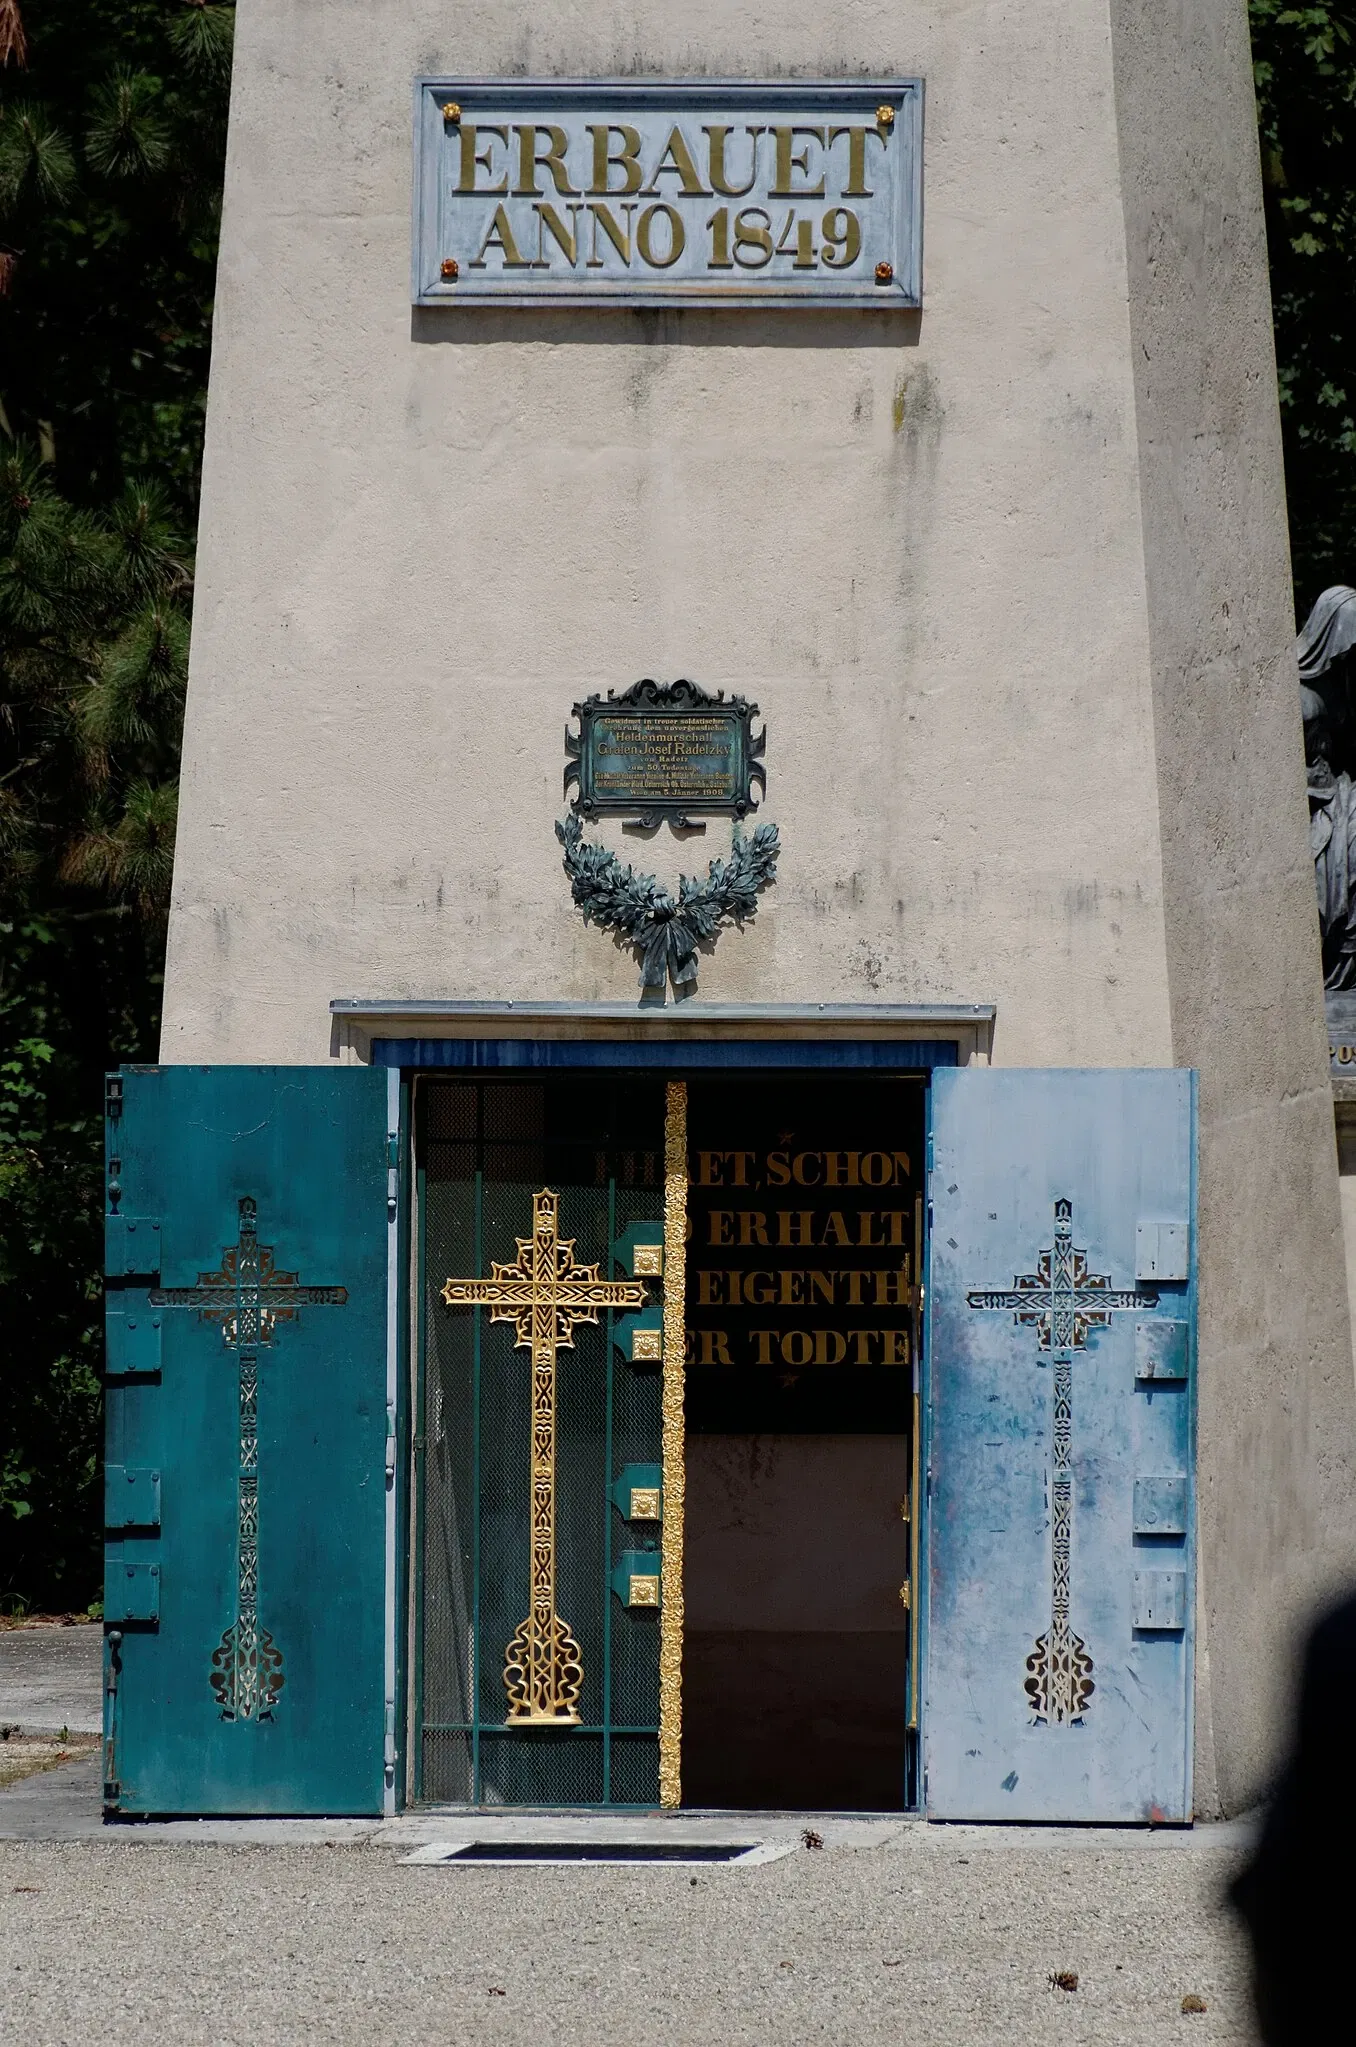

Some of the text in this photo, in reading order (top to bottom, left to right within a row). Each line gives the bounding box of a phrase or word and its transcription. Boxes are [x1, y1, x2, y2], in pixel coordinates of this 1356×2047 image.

[451, 122, 888, 198] ERBAUET
[468, 201, 862, 269] ANNO 1849
[616, 732, 713, 742] Heldenmarschall
[680, 717, 725, 725] soldatischer
[597, 742, 730, 757] Grafen Josef Radetzky
[707, 1211, 910, 1246] ERHALT
[695, 1270, 911, 1305] EIGENTH
[748, 1330, 909, 1365] TODTE
